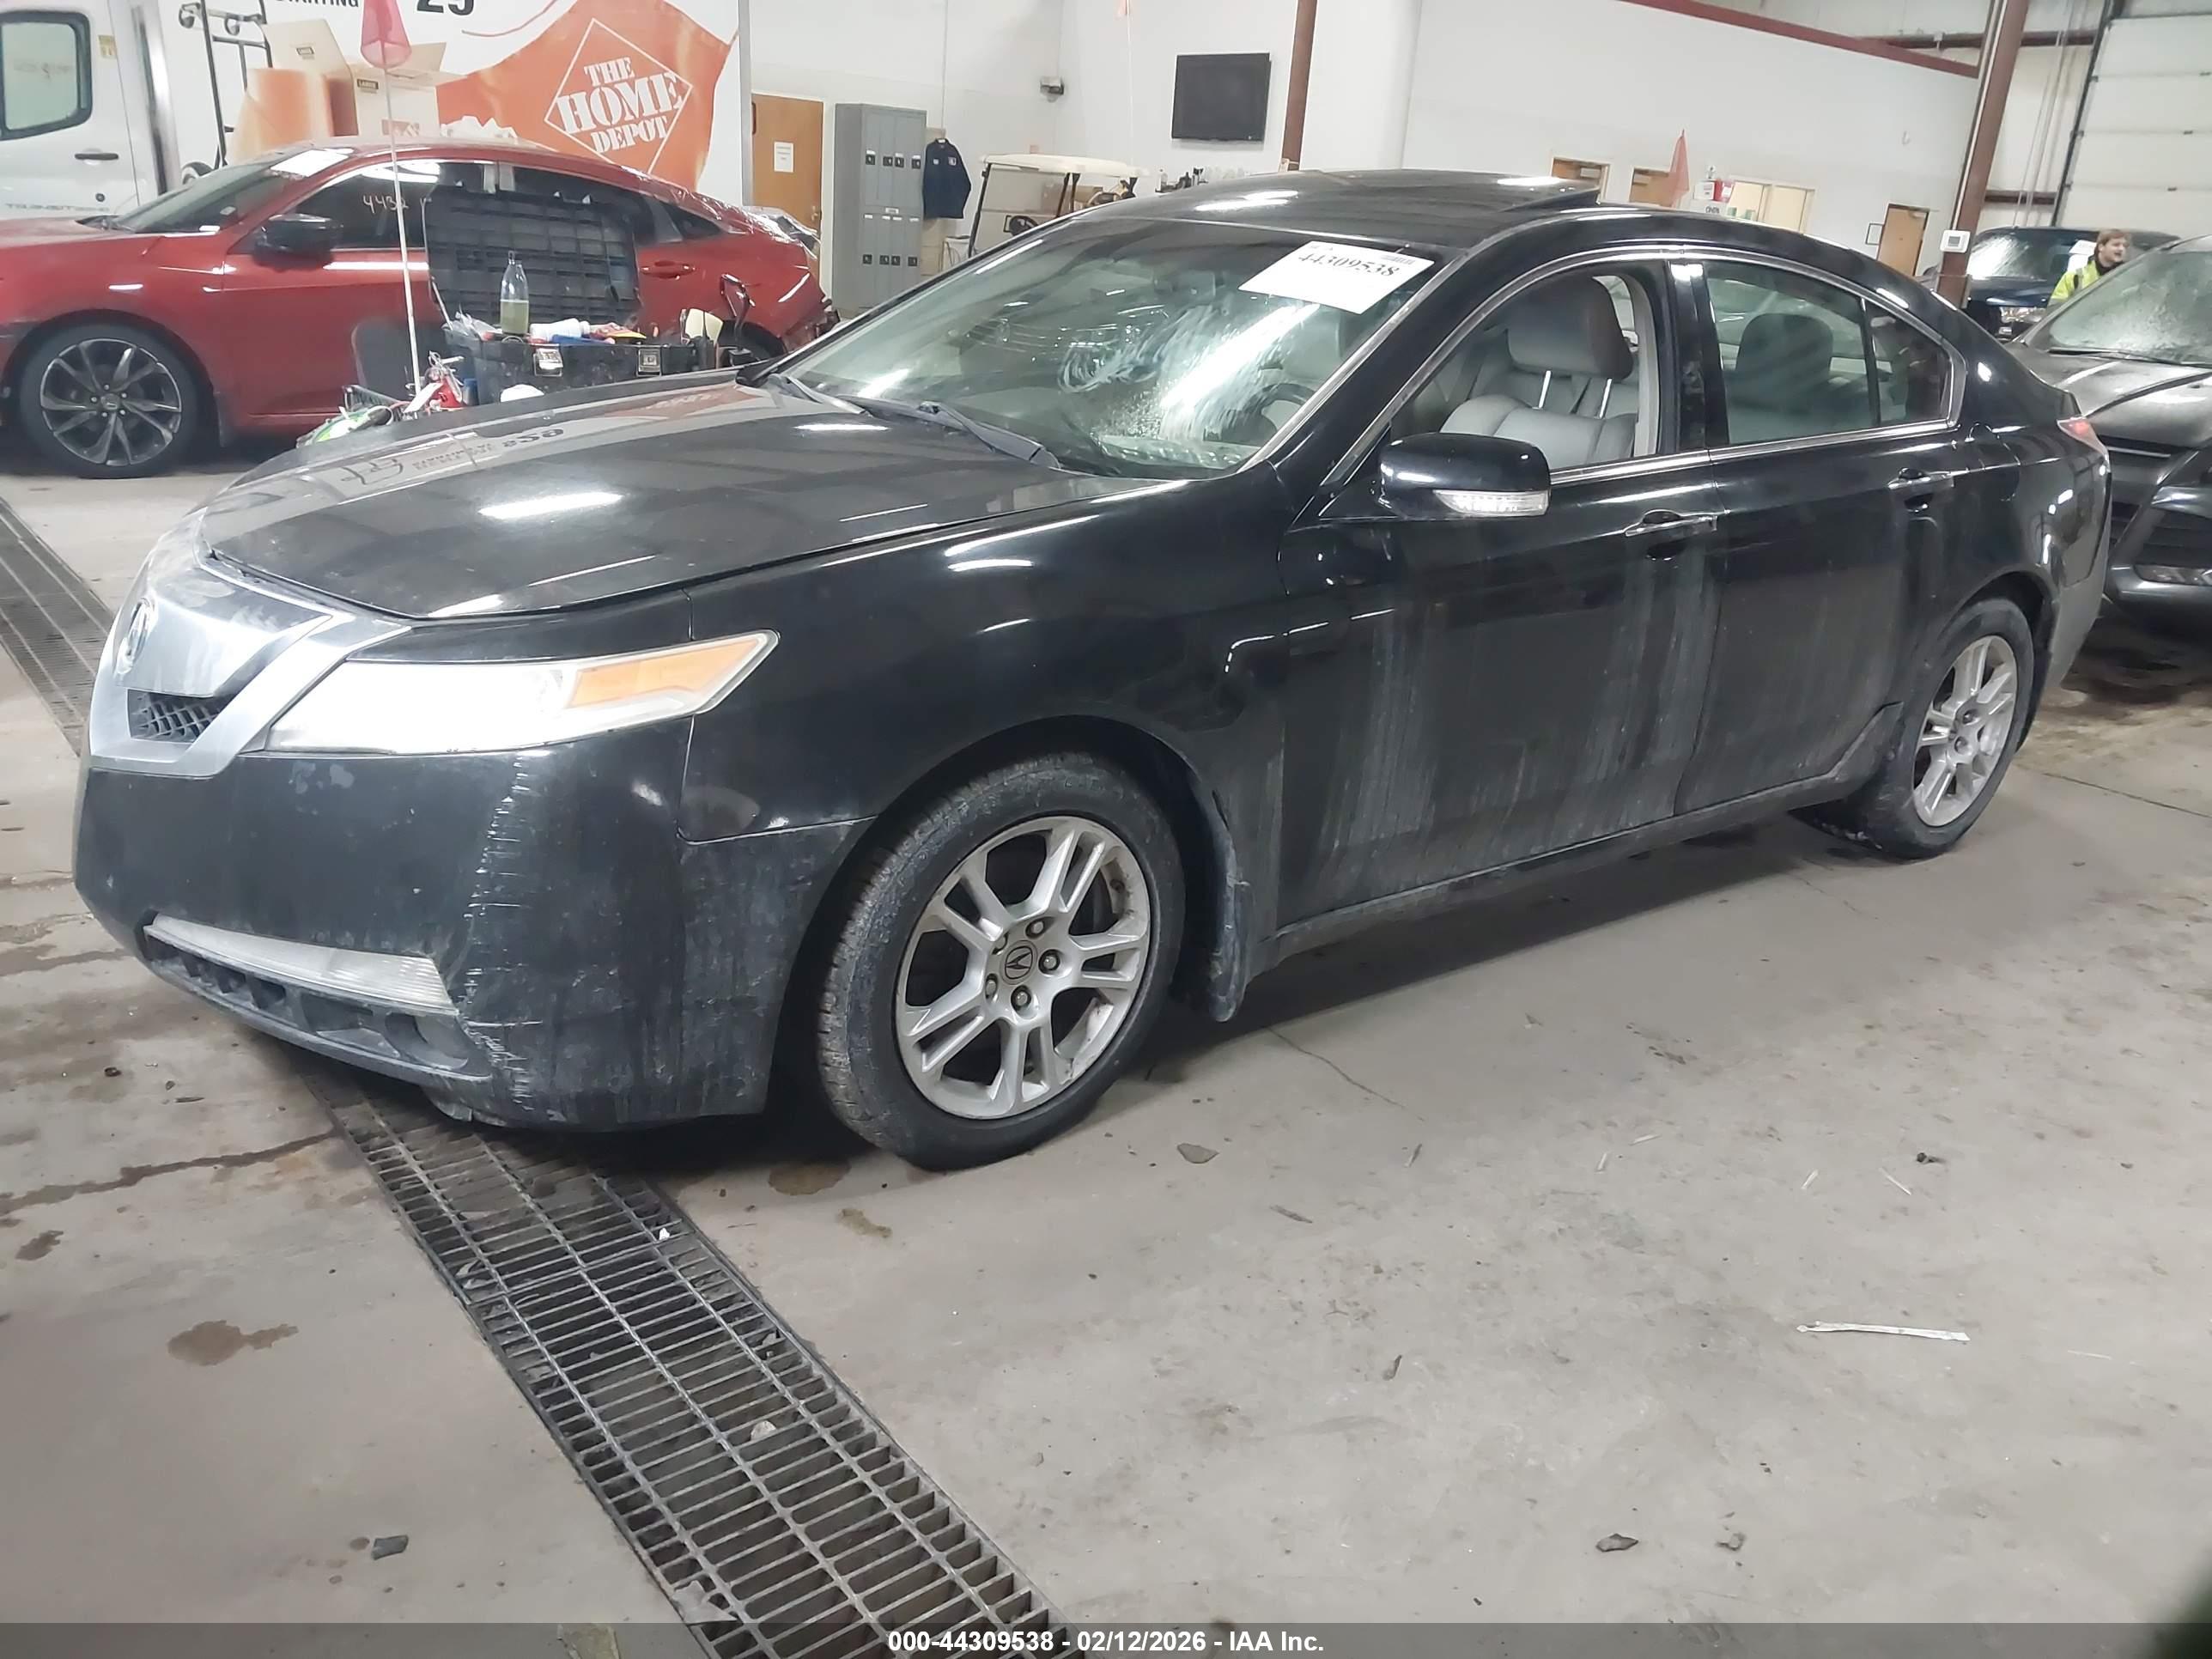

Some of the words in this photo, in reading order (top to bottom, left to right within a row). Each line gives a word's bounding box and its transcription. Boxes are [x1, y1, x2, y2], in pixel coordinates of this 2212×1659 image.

[584, 57, 635, 87] THE
[556, 72, 684, 134] HOME
[590, 116, 668, 153] DEPOT
